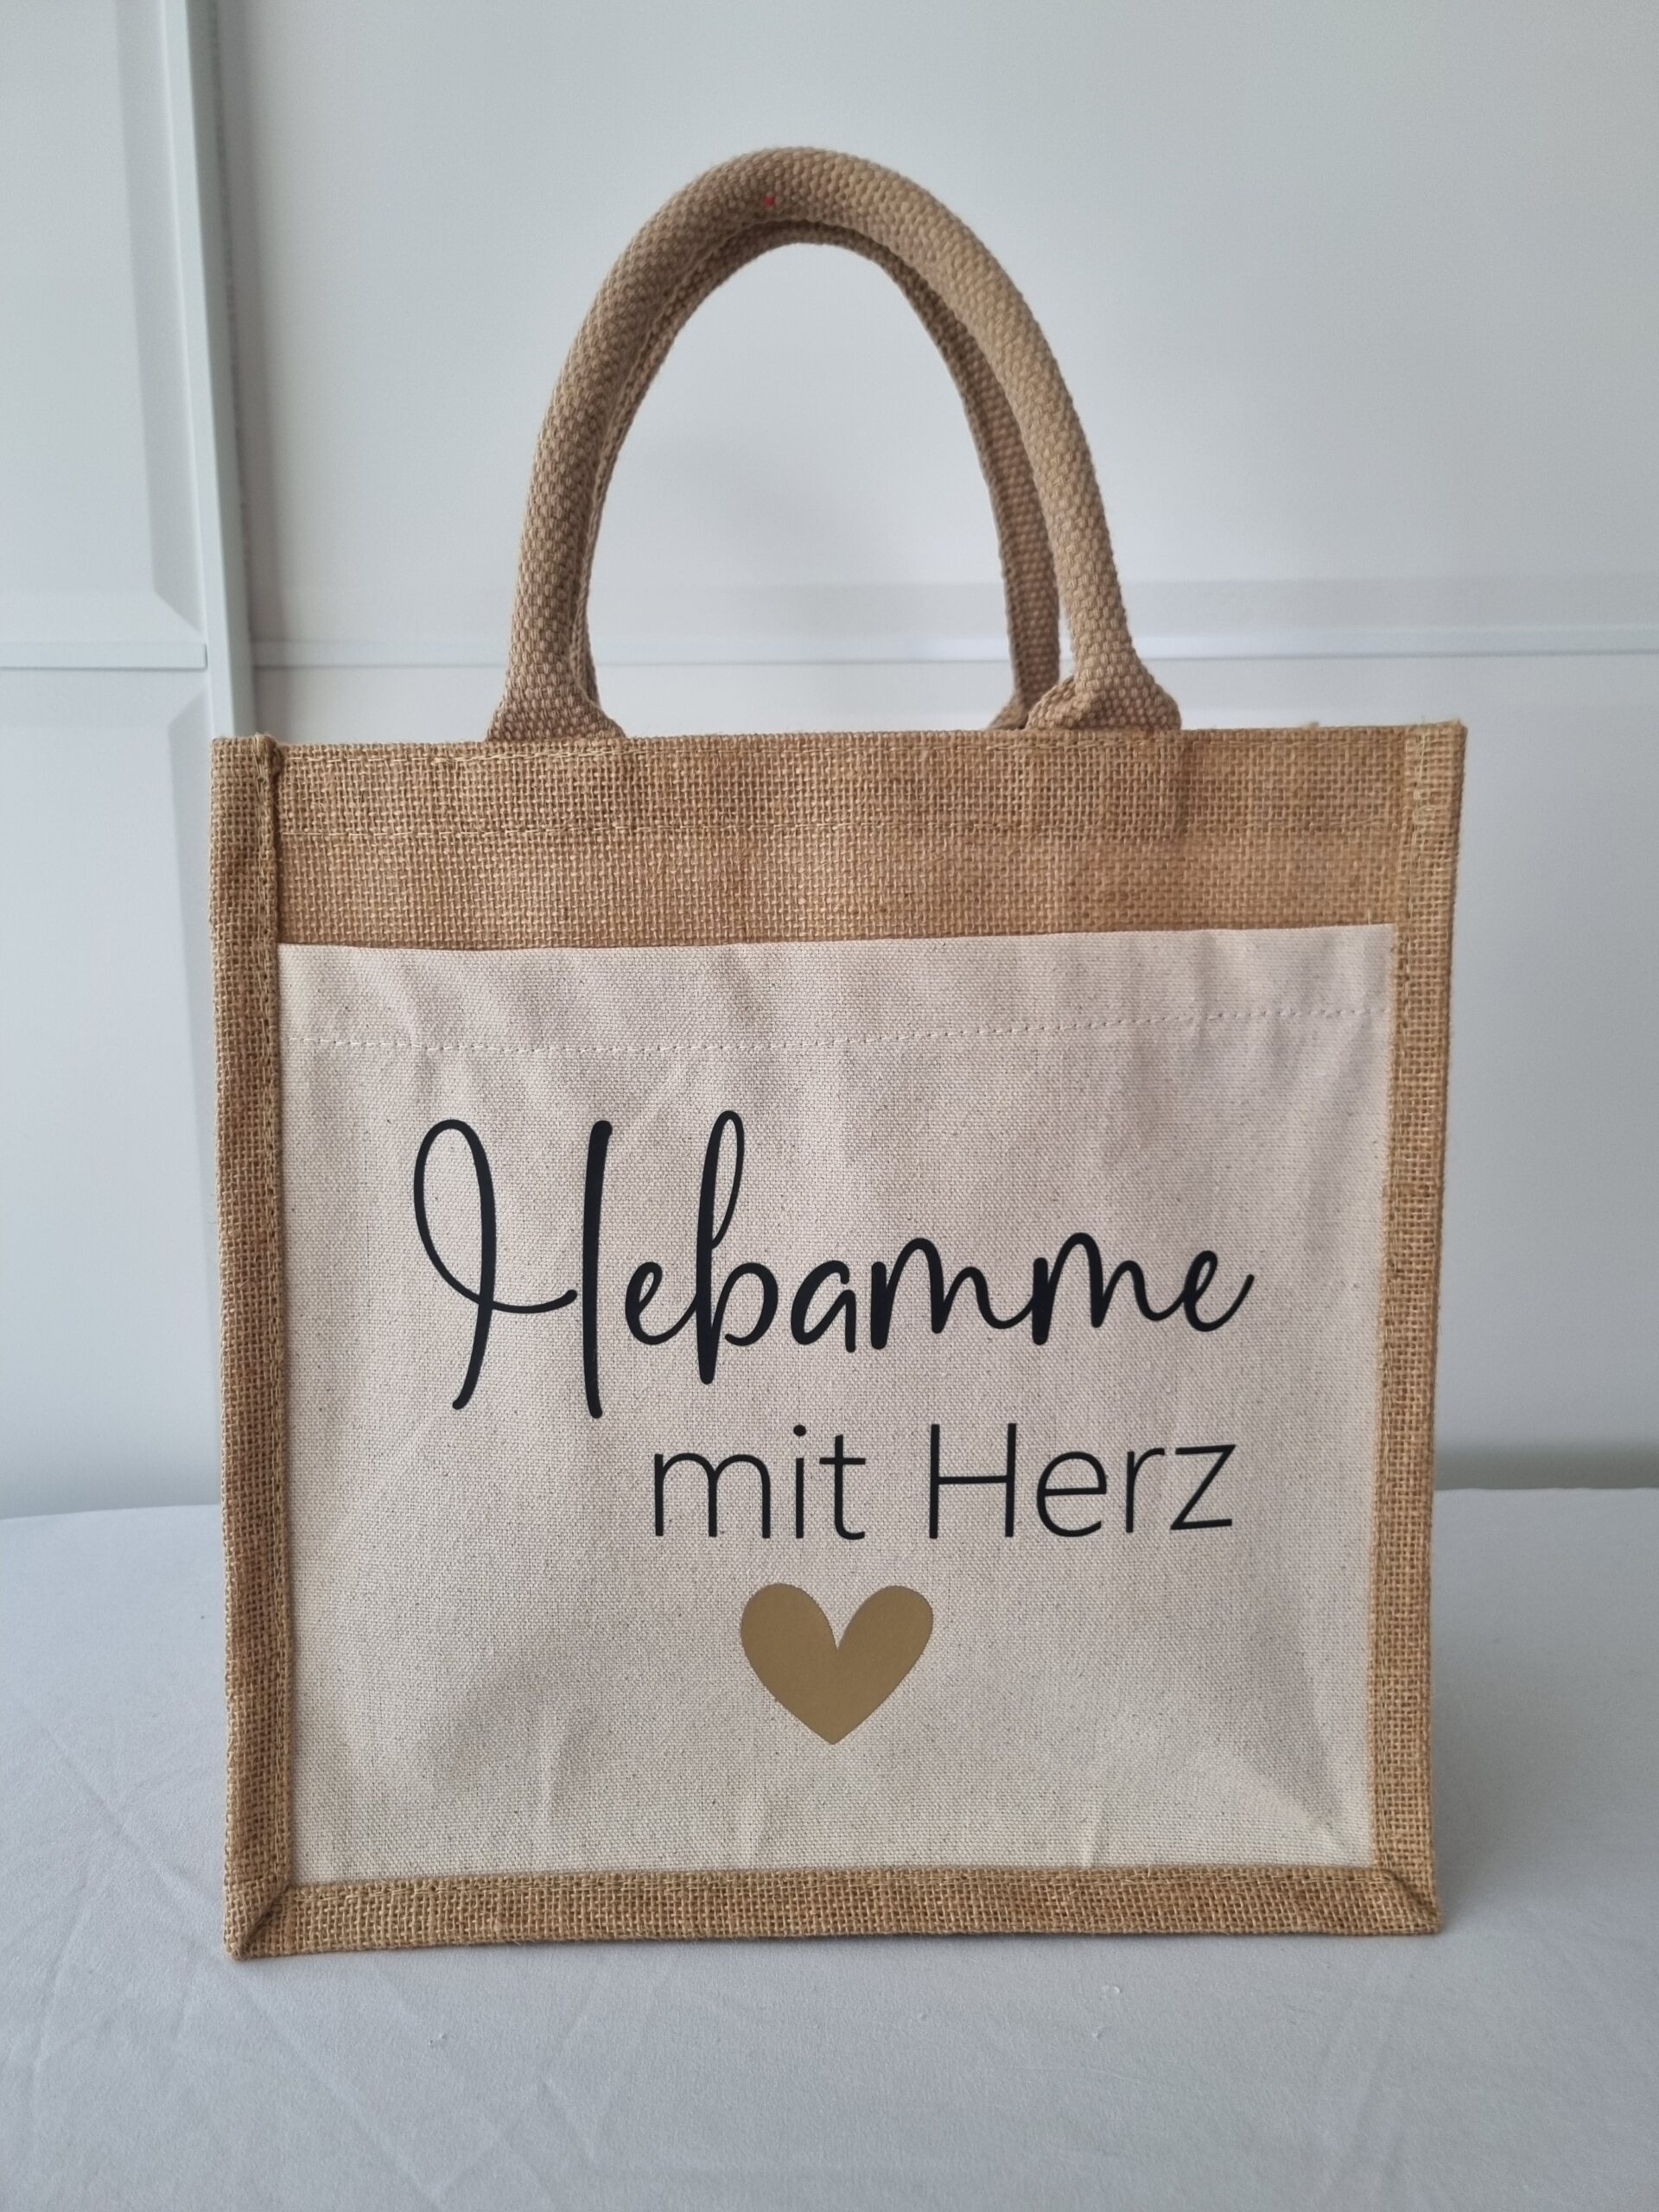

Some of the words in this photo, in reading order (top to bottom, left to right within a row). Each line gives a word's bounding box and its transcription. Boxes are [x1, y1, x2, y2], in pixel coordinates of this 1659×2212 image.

[413, 1109, 1255, 1420] Hebamme
[653, 1424, 867, 1541] mit
[929, 1422, 1236, 1540] Herz
